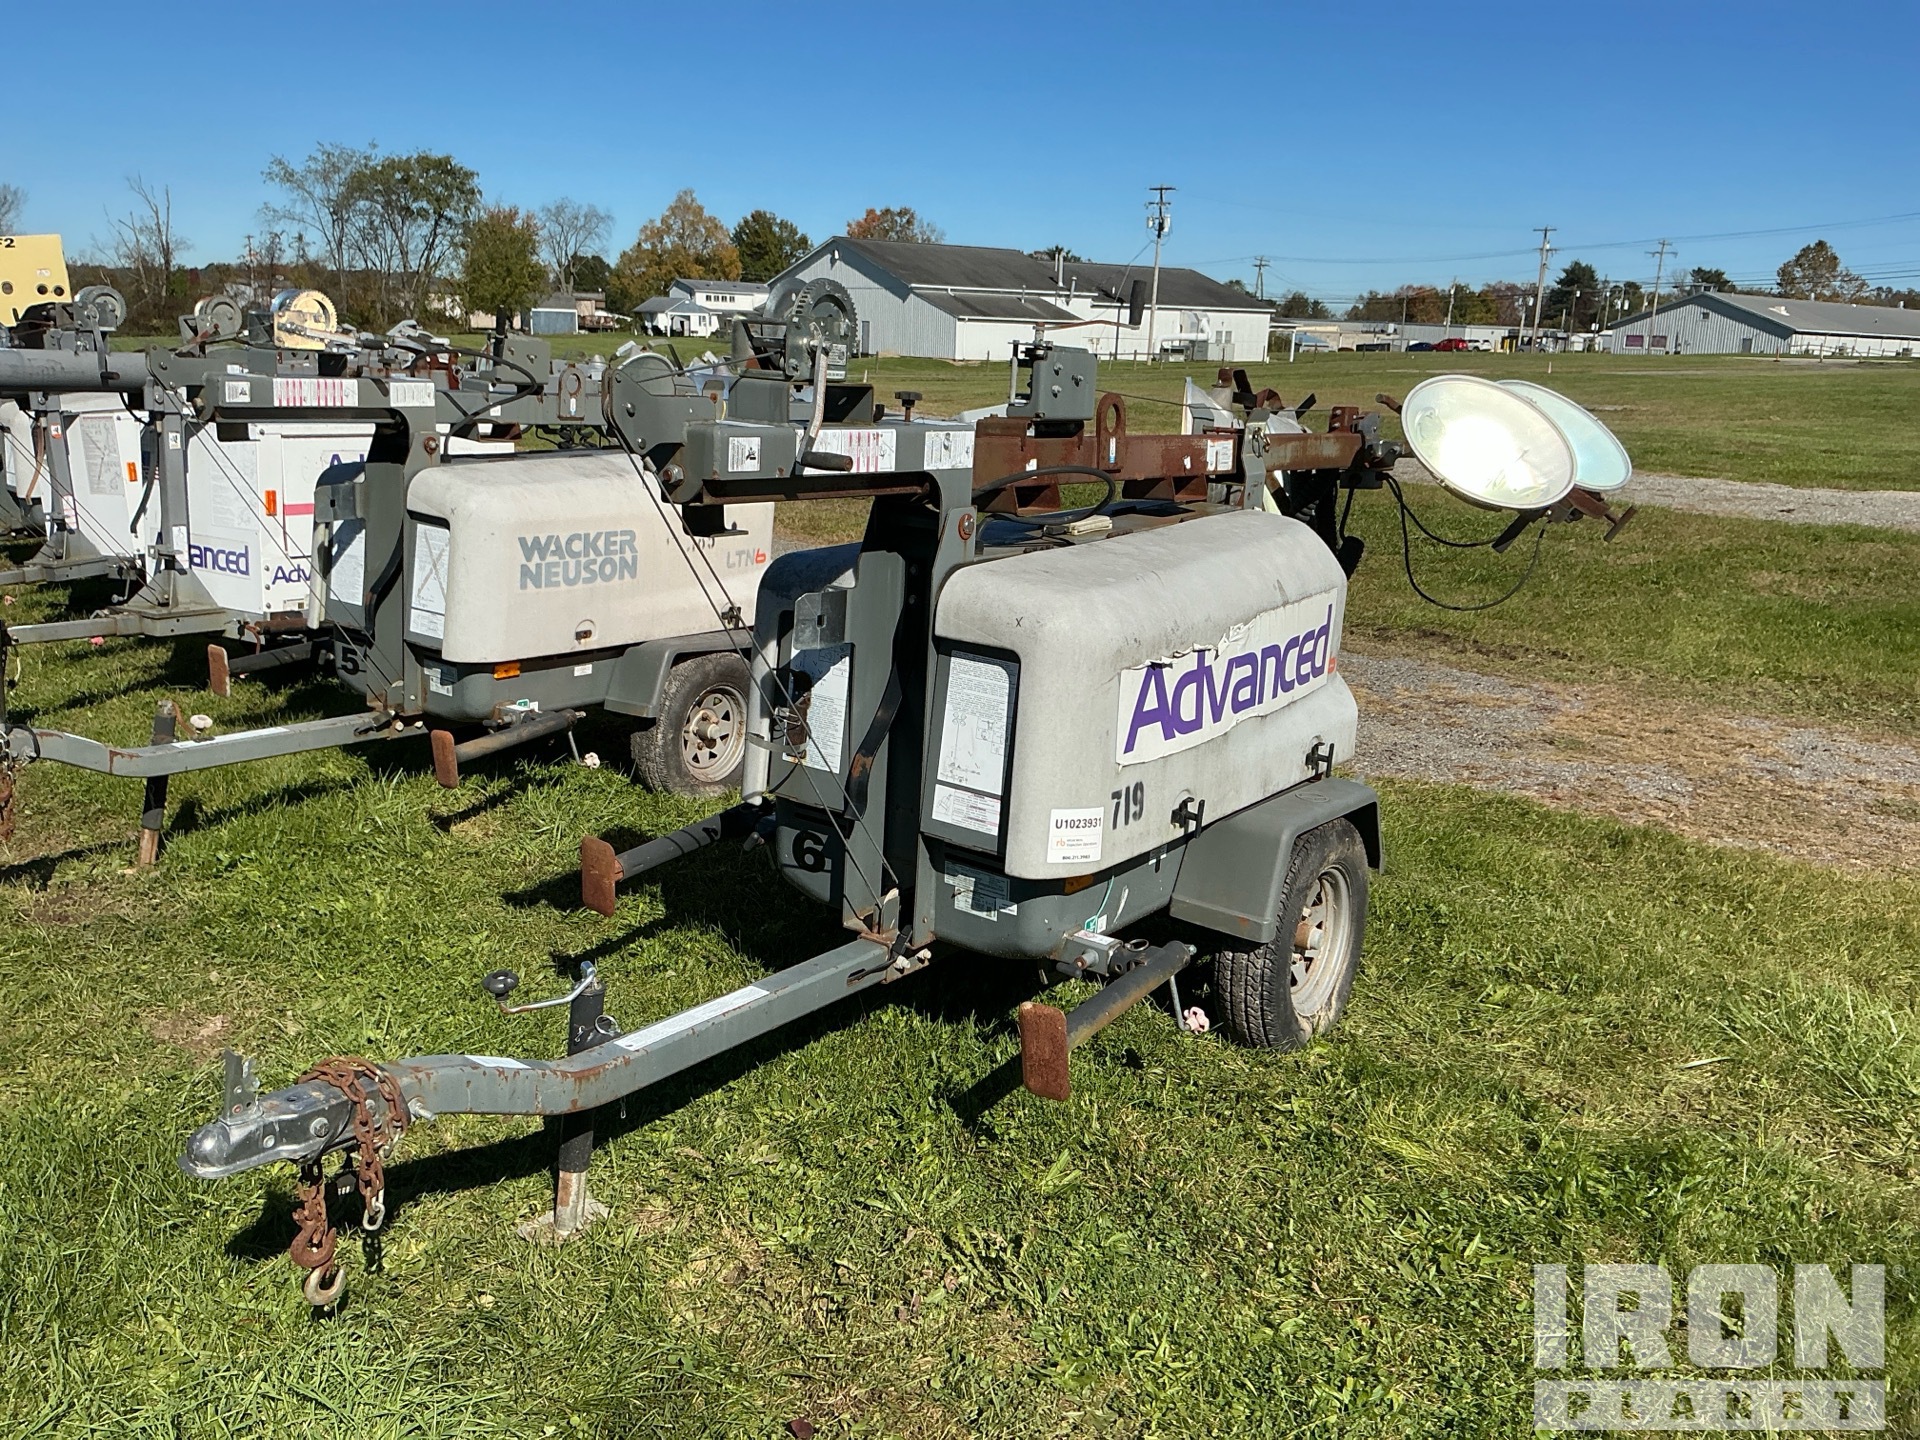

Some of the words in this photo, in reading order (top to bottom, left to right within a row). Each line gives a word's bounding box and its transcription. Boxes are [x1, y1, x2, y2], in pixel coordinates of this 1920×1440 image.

[518, 530, 638, 562] WACKER
[726, 548, 766, 569] LTN6
[520, 555, 638, 590] NEUSON
[1123, 603, 1332, 754] Advanced
[1055, 817, 1102, 829] U1023931
[1111, 781, 1144, 830] 719
[792, 830, 825, 873] 6
